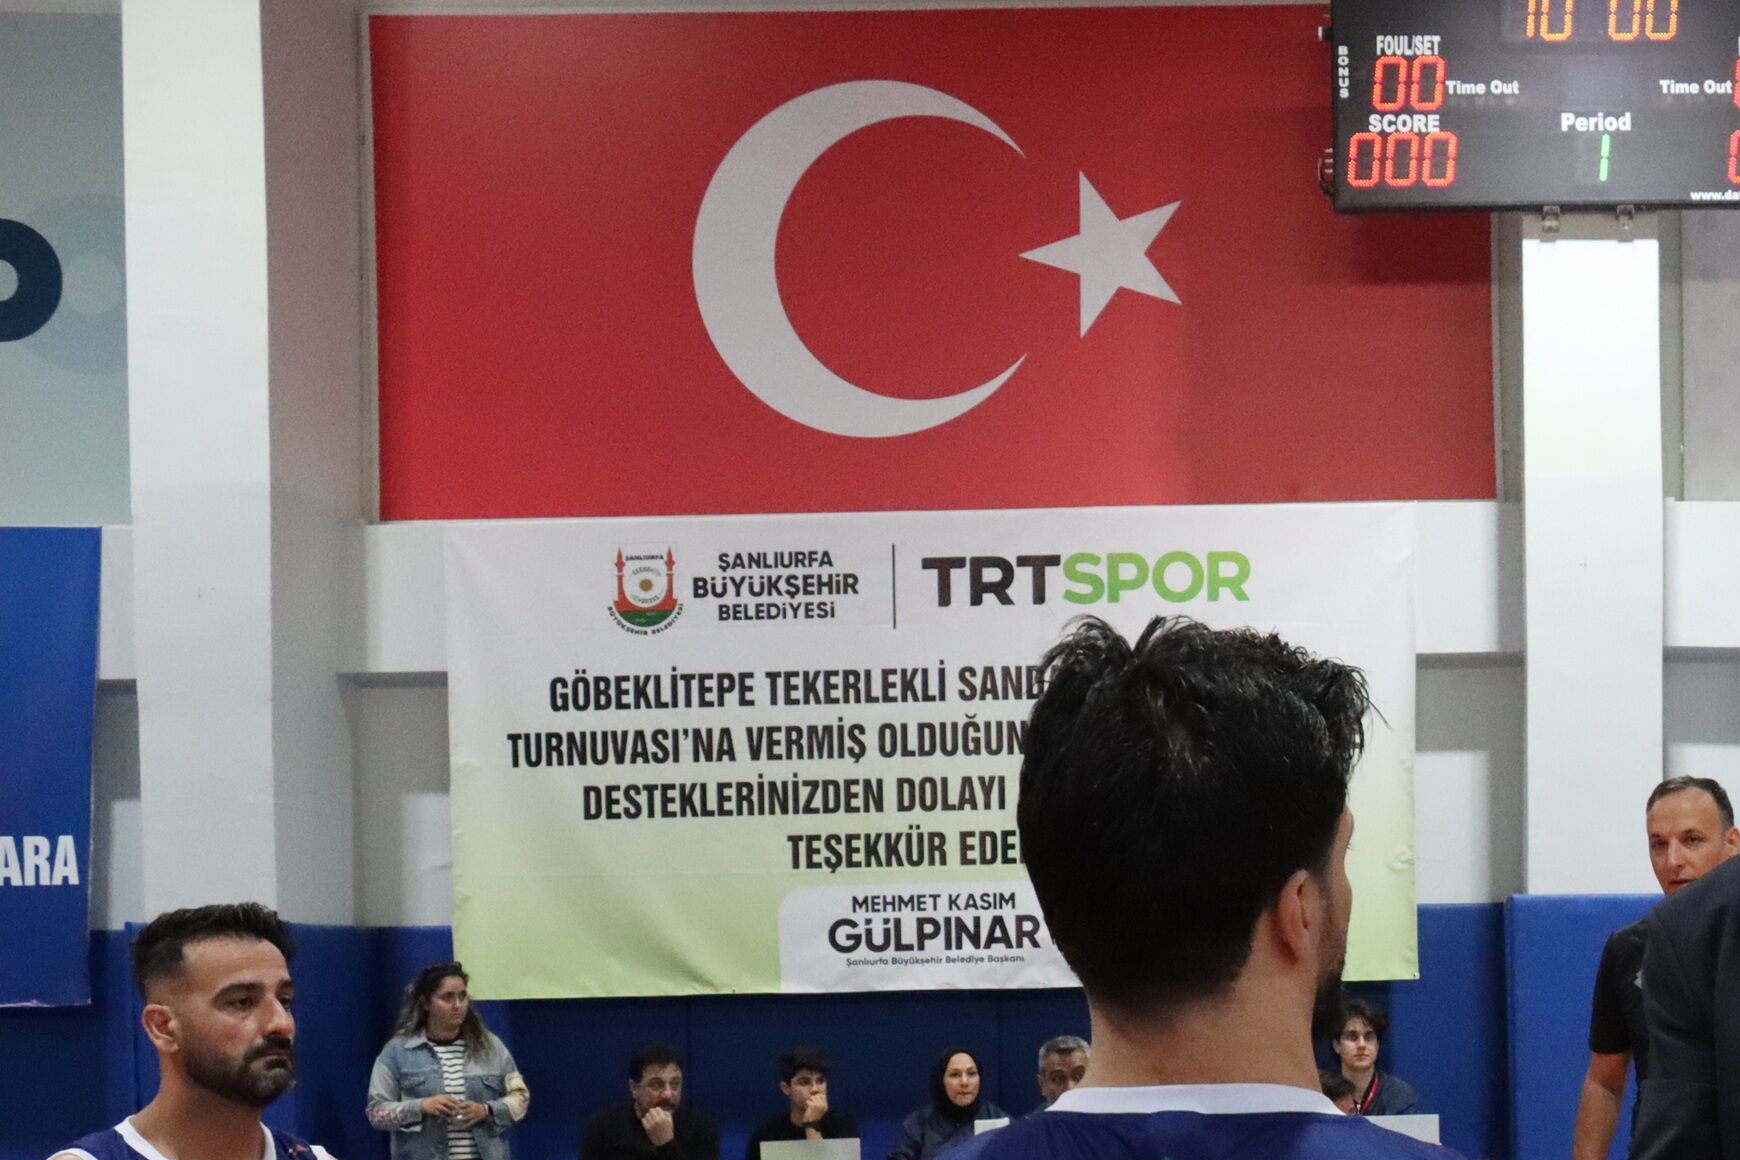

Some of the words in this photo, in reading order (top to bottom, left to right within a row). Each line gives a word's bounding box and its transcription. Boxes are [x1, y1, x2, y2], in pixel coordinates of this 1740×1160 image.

[1376, 35, 1441, 55] FOUL/SET
[1338, 45, 1349, 98] BONUS
[1372, 55, 1446, 111] 00
[1445, 80, 1487, 95] Time
[1491, 80, 1520, 95] Out
[1659, 80, 1699, 94] Time
[1703, 80, 1733, 94] Out
[1368, 113, 1440, 133] SCORE
[1560, 112, 1632, 132] Period
[1347, 131, 1458, 188] 000
[718, 549, 833, 572] ŞANLIURFA
[693, 572, 860, 600] BÜYÜKŞEHİR
[718, 600, 836, 622] BELEDİYESİ
[549, 666, 755, 712] GÖBEKLİTEPE
[765, 659, 946, 707] TEKERLEKLİ
[958, 664, 1057, 702] SAND
[507, 727, 737, 768] TURNUVASI'NA
[745, 717, 867, 764] VERMİŞ
[583, 772, 884, 820] DESTEKLERİNİZDEN
[896, 775, 1006, 813] DOLAYI
[0, 834, 80, 886] ARA
[787, 824, 947, 874] TEŞEKKÜR
[959, 830, 1025, 867] EDE
[852, 894, 941, 913] MEHMET
[949, 892, 1016, 911] KASIM
[828, 914, 1042, 953] GÜLPINAR
[945, 955, 985, 965] Belediye
